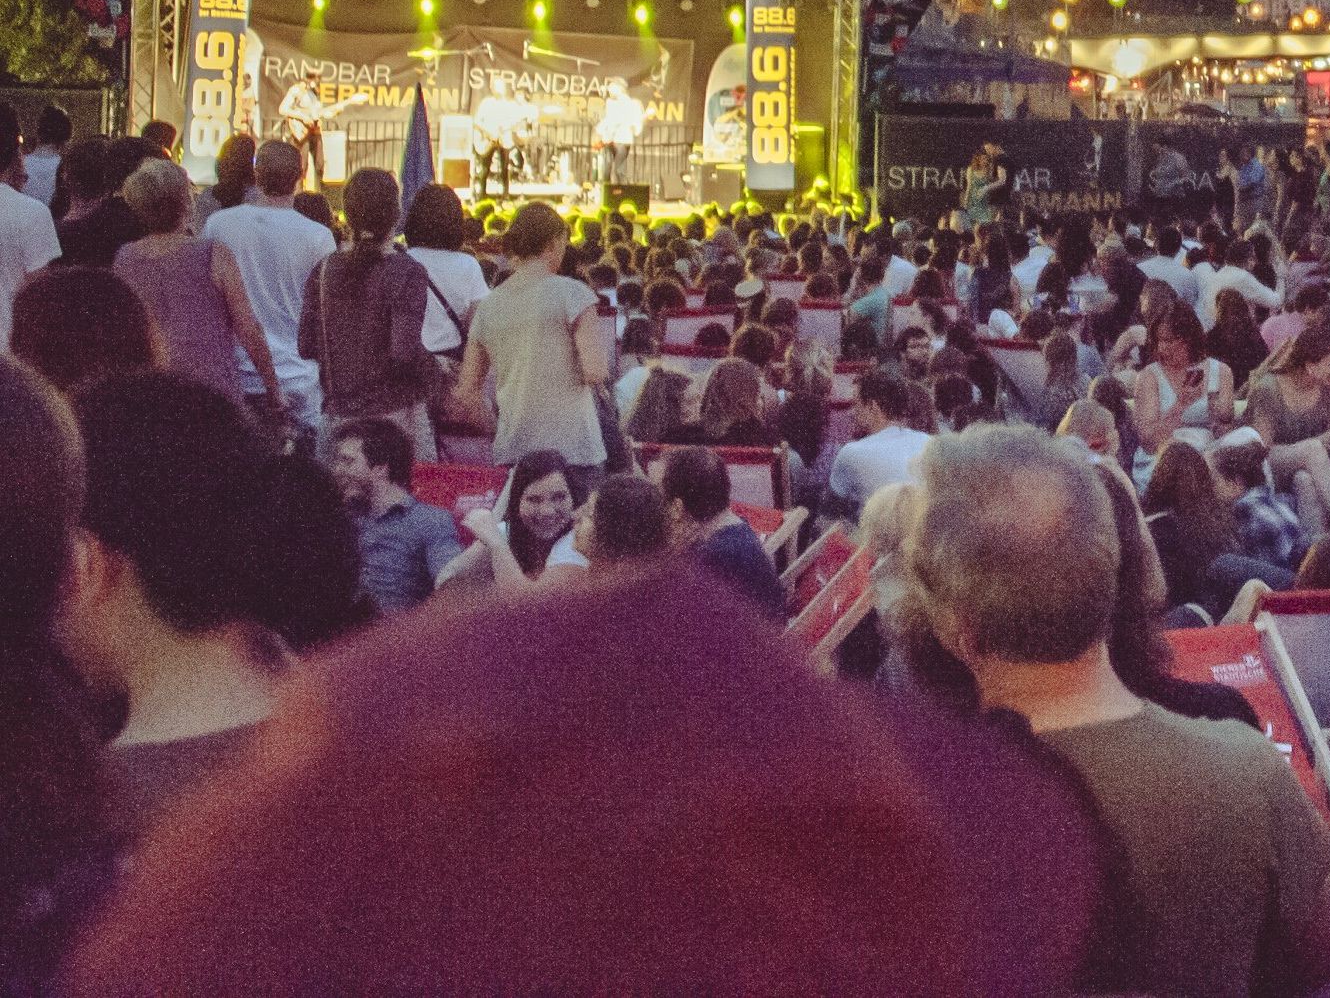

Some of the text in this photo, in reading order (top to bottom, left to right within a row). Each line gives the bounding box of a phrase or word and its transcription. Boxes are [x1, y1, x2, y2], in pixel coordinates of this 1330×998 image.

[753, 6, 796, 25] 88.6
[263, 56, 391, 85] RANDBAR
[190, 31, 235, 157] 88.6
[319, 83, 459, 110] ERRMANN
[752, 45, 788, 164] 88.6
